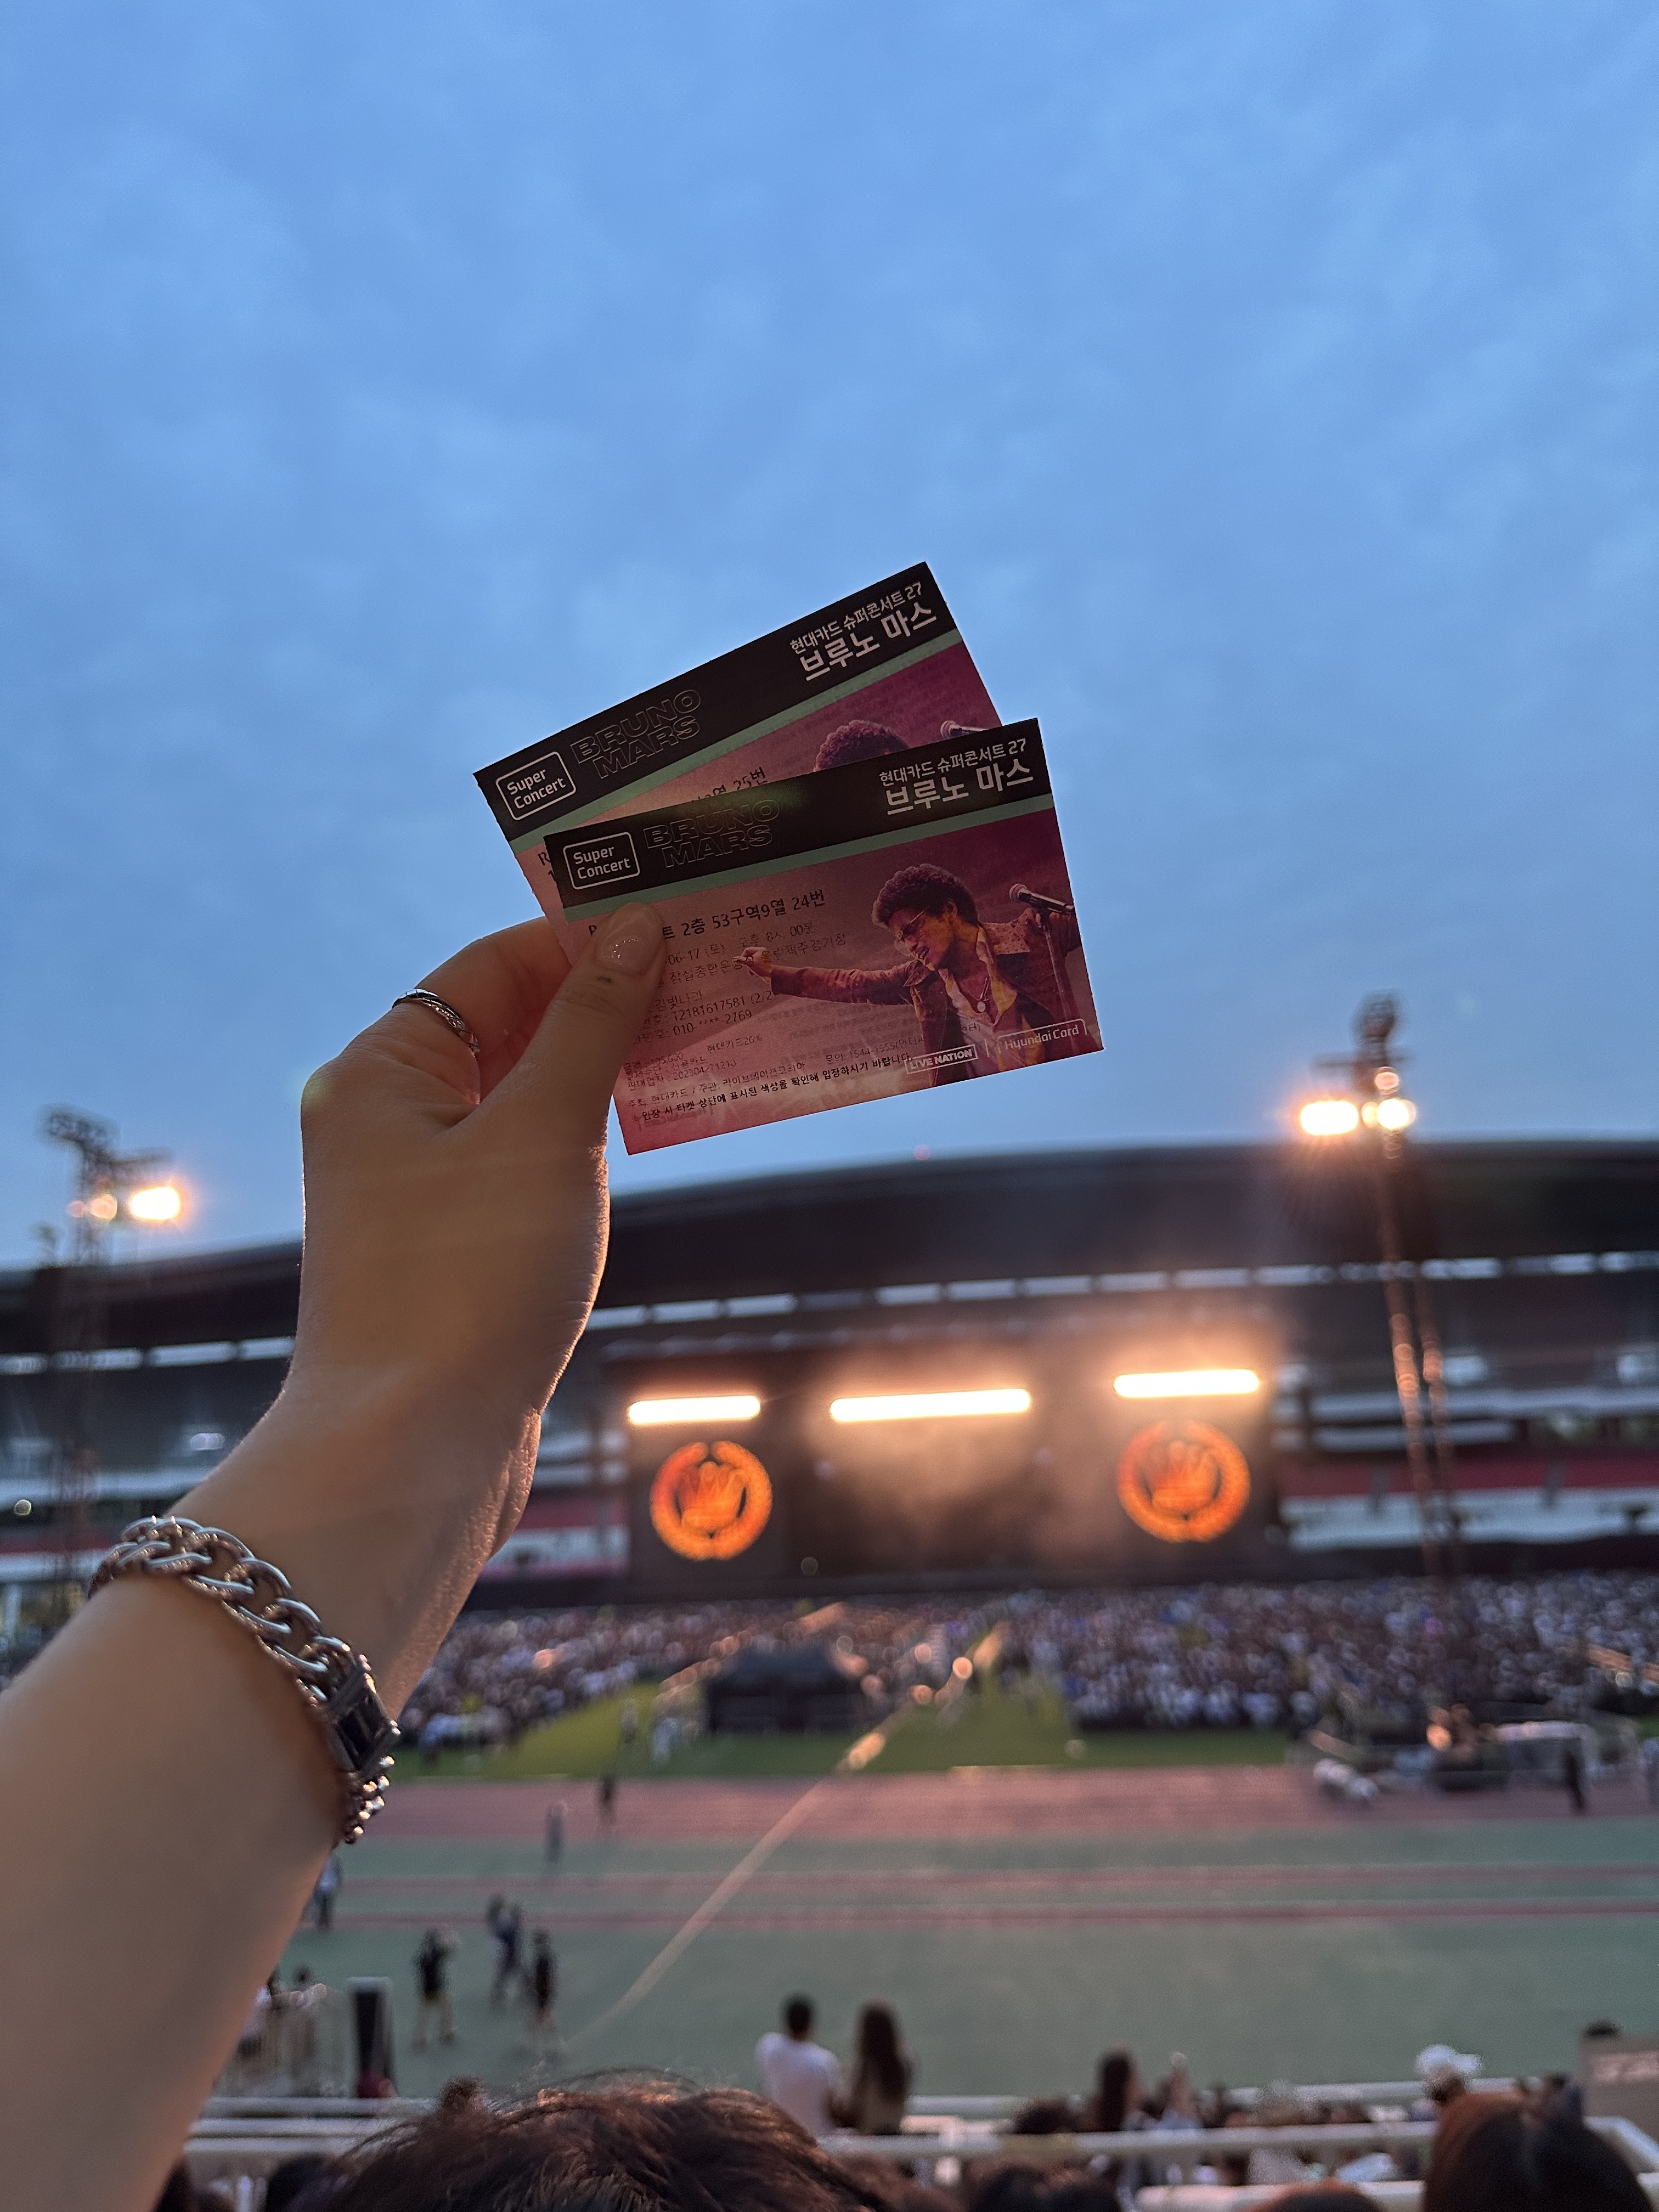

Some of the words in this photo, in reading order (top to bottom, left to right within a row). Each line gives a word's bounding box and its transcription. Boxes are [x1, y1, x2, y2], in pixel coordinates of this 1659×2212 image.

[789, 620, 843, 654] 현대카드
[843, 591, 906, 630] 슈퍼콘서트
[904, 582, 922, 600] 27
[799, 633, 881, 681] 브루노
[880, 599, 938, 641] 마스
[570, 690, 701, 764] BRUNO
[592, 715, 700, 779] MARS
[506, 768, 548, 796] Super
[879, 761, 935, 787] 현대카드
[937, 743, 1007, 773] 슈퍼콘서트
[1007, 738, 1026, 755] 27
[514, 778, 566, 809] Concert
[885, 776, 969, 815] 브루노
[975, 758, 1034, 792] 마스
[643, 799, 778, 849] BRUNO
[661, 825, 773, 868] MARS
[573, 845, 616, 866] Super
[577, 858, 631, 879] Concert
[681, 918, 706, 936] 2층
[712, 898, 786, 929] 53구역9열
[791, 889, 826, 911] 24번
[910, 1057, 933, 1069] LIVE
[934, 1048, 972, 1064] NATION
[1005, 1030, 1052, 1050] Hyundai
[1053, 1024, 1079, 1039] Card
[642, 1108, 661, 1121] 입장
[664, 1105, 673, 1115] 시
[676, 1100, 695, 1112] 티켓
[698, 1093, 726, 1108] 상단에
[730, 1086, 758, 1100] 표시된
[760, 1080, 788, 1093] 색상을
[791, 1072, 820, 1086] 확인해
[822, 1061, 868, 1080] 입장하시기
[872, 1052, 913, 1068] 바랍니다.
[651, 1088, 688, 1102] 현대카드
